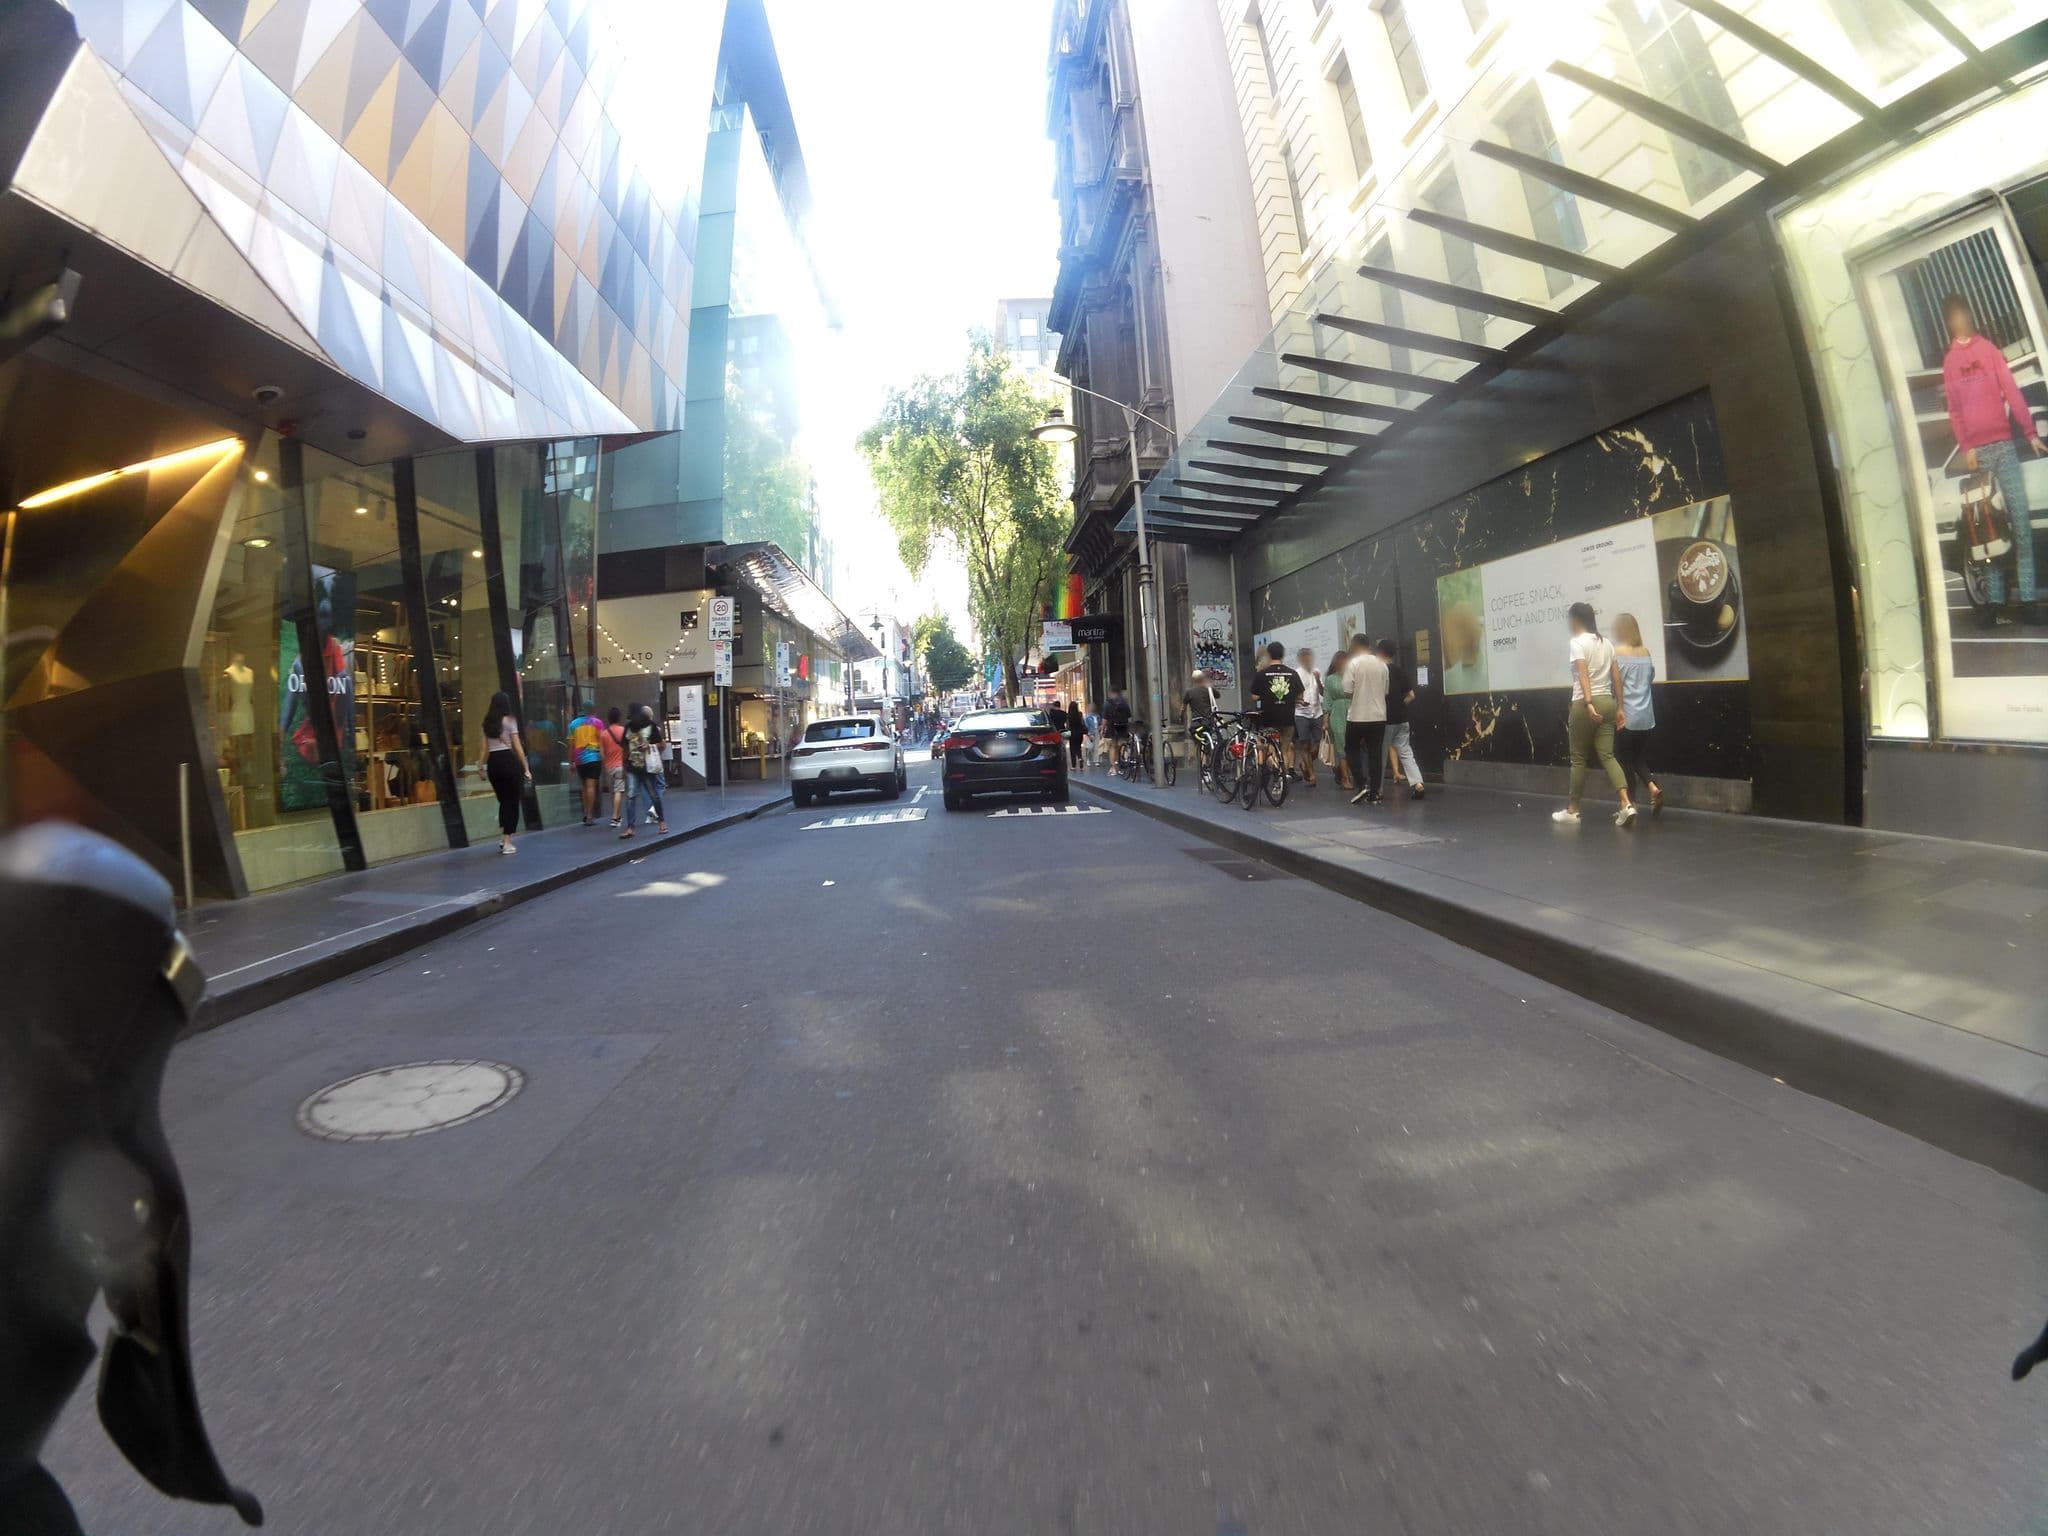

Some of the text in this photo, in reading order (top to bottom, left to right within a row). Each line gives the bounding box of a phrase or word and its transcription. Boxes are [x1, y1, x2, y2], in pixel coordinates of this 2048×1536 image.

[716, 604, 726, 612] 20
[1492, 614, 1521, 631] LUNCH
[1525, 609, 1545, 625] AND
[1078, 628, 1104, 637] mantra
[1493, 636, 1517, 647] EMPORIUM
[622, 652, 653, 662] ALTO
[287, 673, 350, 695] ORON
